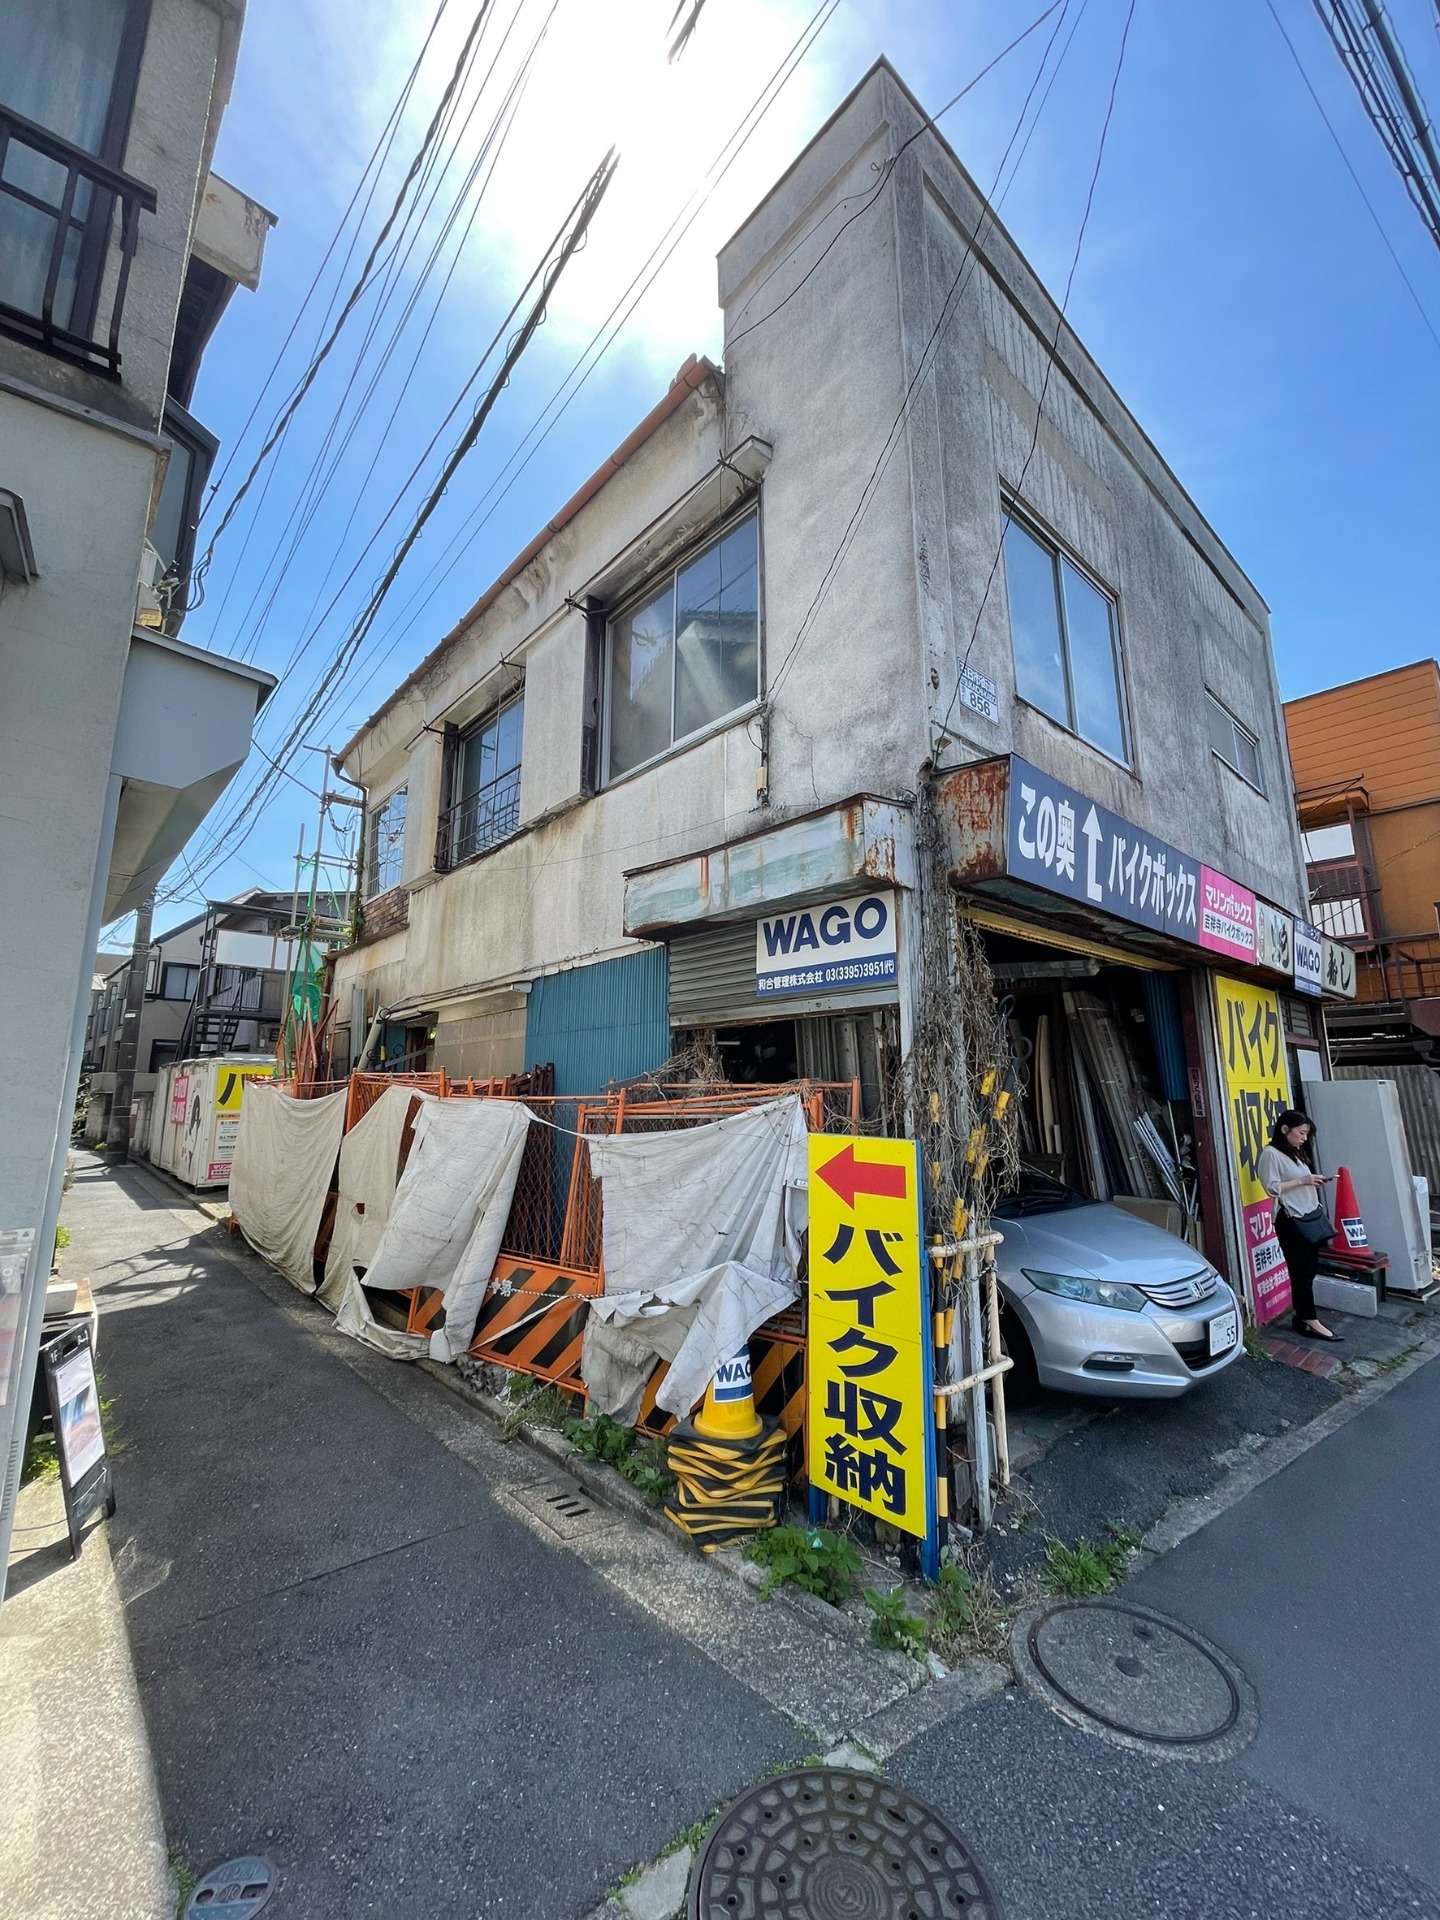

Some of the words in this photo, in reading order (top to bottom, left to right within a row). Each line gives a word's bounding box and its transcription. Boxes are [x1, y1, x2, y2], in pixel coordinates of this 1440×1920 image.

[1018, 783, 1075, 881] この奥
[1109, 834, 1197, 928] バイクボックス
[763, 898, 887, 957] WAGO
[1205, 884, 1253, 923] マリンボックス
[758, 971, 823, 991] 和合管理株式会社
[1296, 942, 1320, 973] WAGO
[1226, 998, 1279, 1078] バイク
[1249, 1211, 1276, 1240] マリン
[823, 1223, 908, 1515] バイク収納
